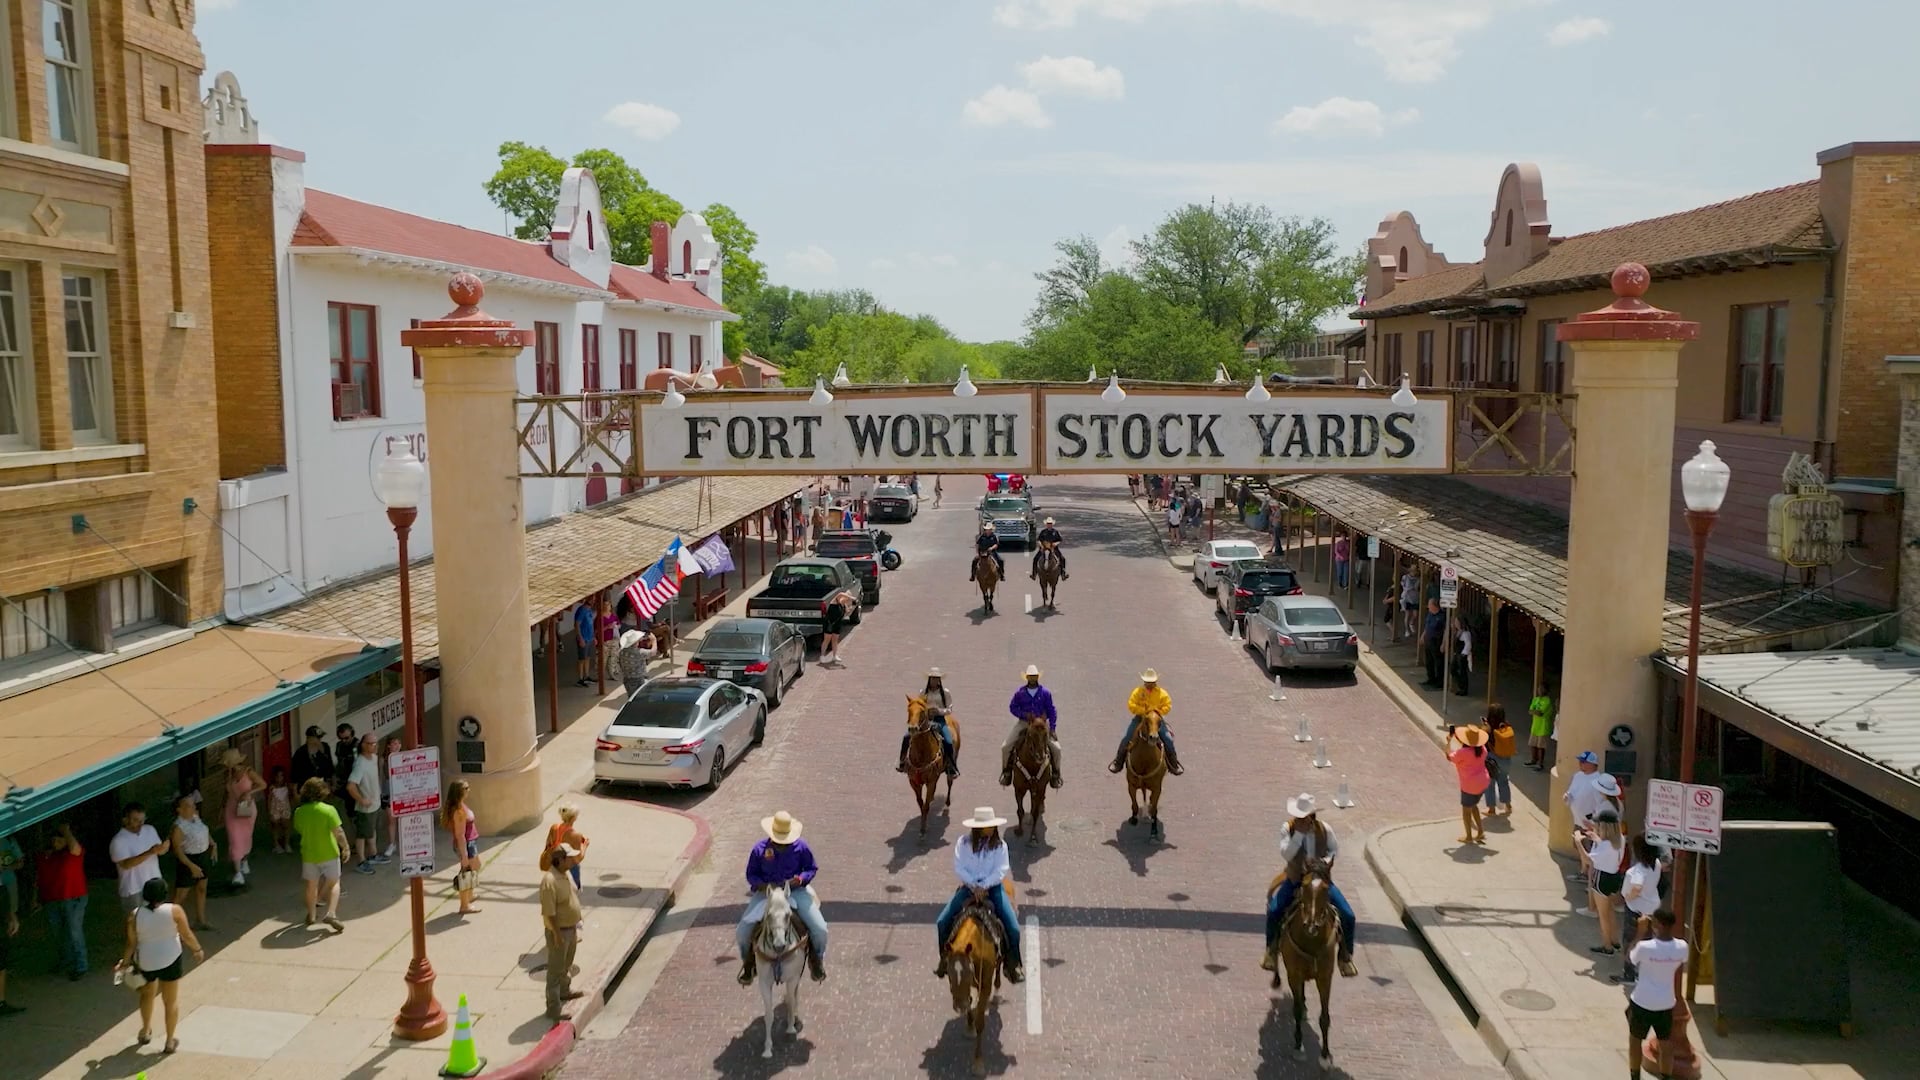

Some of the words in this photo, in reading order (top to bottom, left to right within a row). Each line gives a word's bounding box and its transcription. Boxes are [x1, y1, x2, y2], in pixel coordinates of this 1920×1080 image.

[684, 415, 822, 459] FORT
[845, 413, 1019, 458] WORTH
[1057, 413, 1225, 458] STOCK
[1248, 411, 1416, 458] YARDS
[1660, 784, 1673, 792] NO
[410, 816, 422, 825] NO
